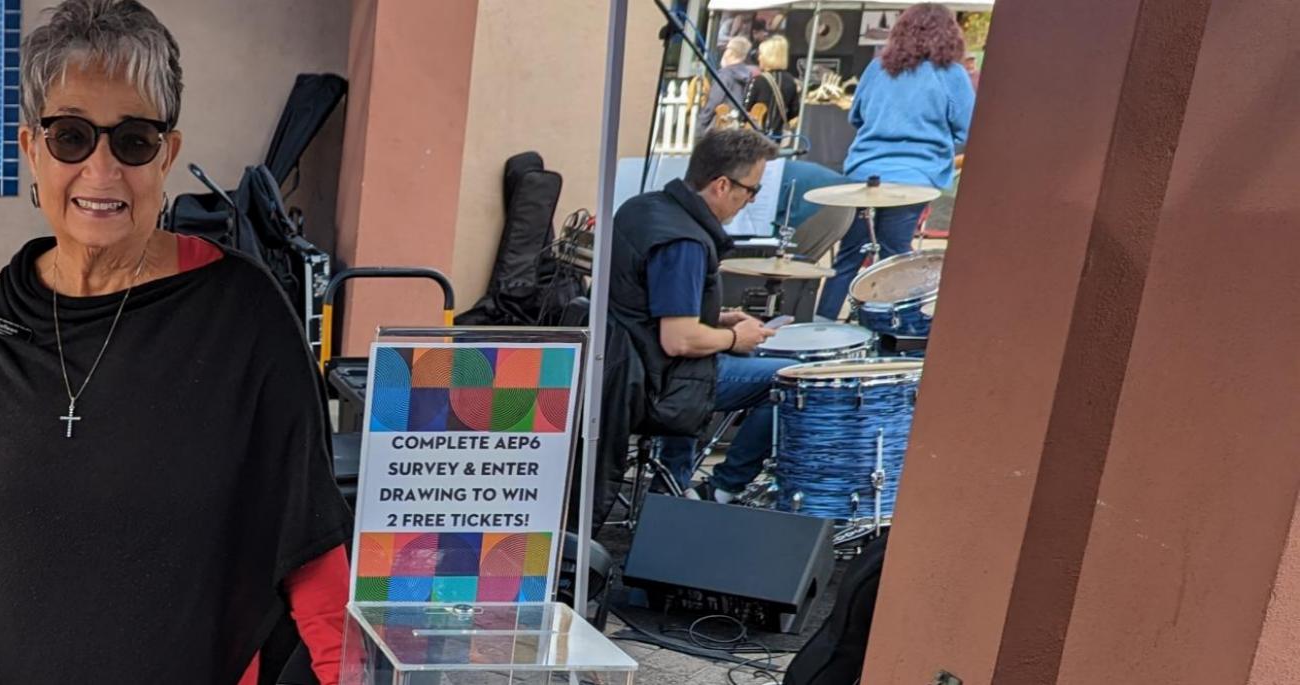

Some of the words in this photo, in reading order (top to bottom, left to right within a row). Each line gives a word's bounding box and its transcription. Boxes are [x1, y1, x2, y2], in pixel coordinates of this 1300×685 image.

[391, 435, 489, 450] COMPLETE
[494, 435, 541, 450] AEP6
[387, 461, 460, 476] SURVEY
[463, 461, 476, 476] &
[481, 461, 539, 476] ENTER
[379, 487, 469, 502] DRAWING
[474, 487, 497, 502] TO
[502, 487, 538, 502] WIN
[386, 513, 398, 527] 2
[402, 513, 445, 527] FREE
[450, 513, 530, 527] TICKETS!
